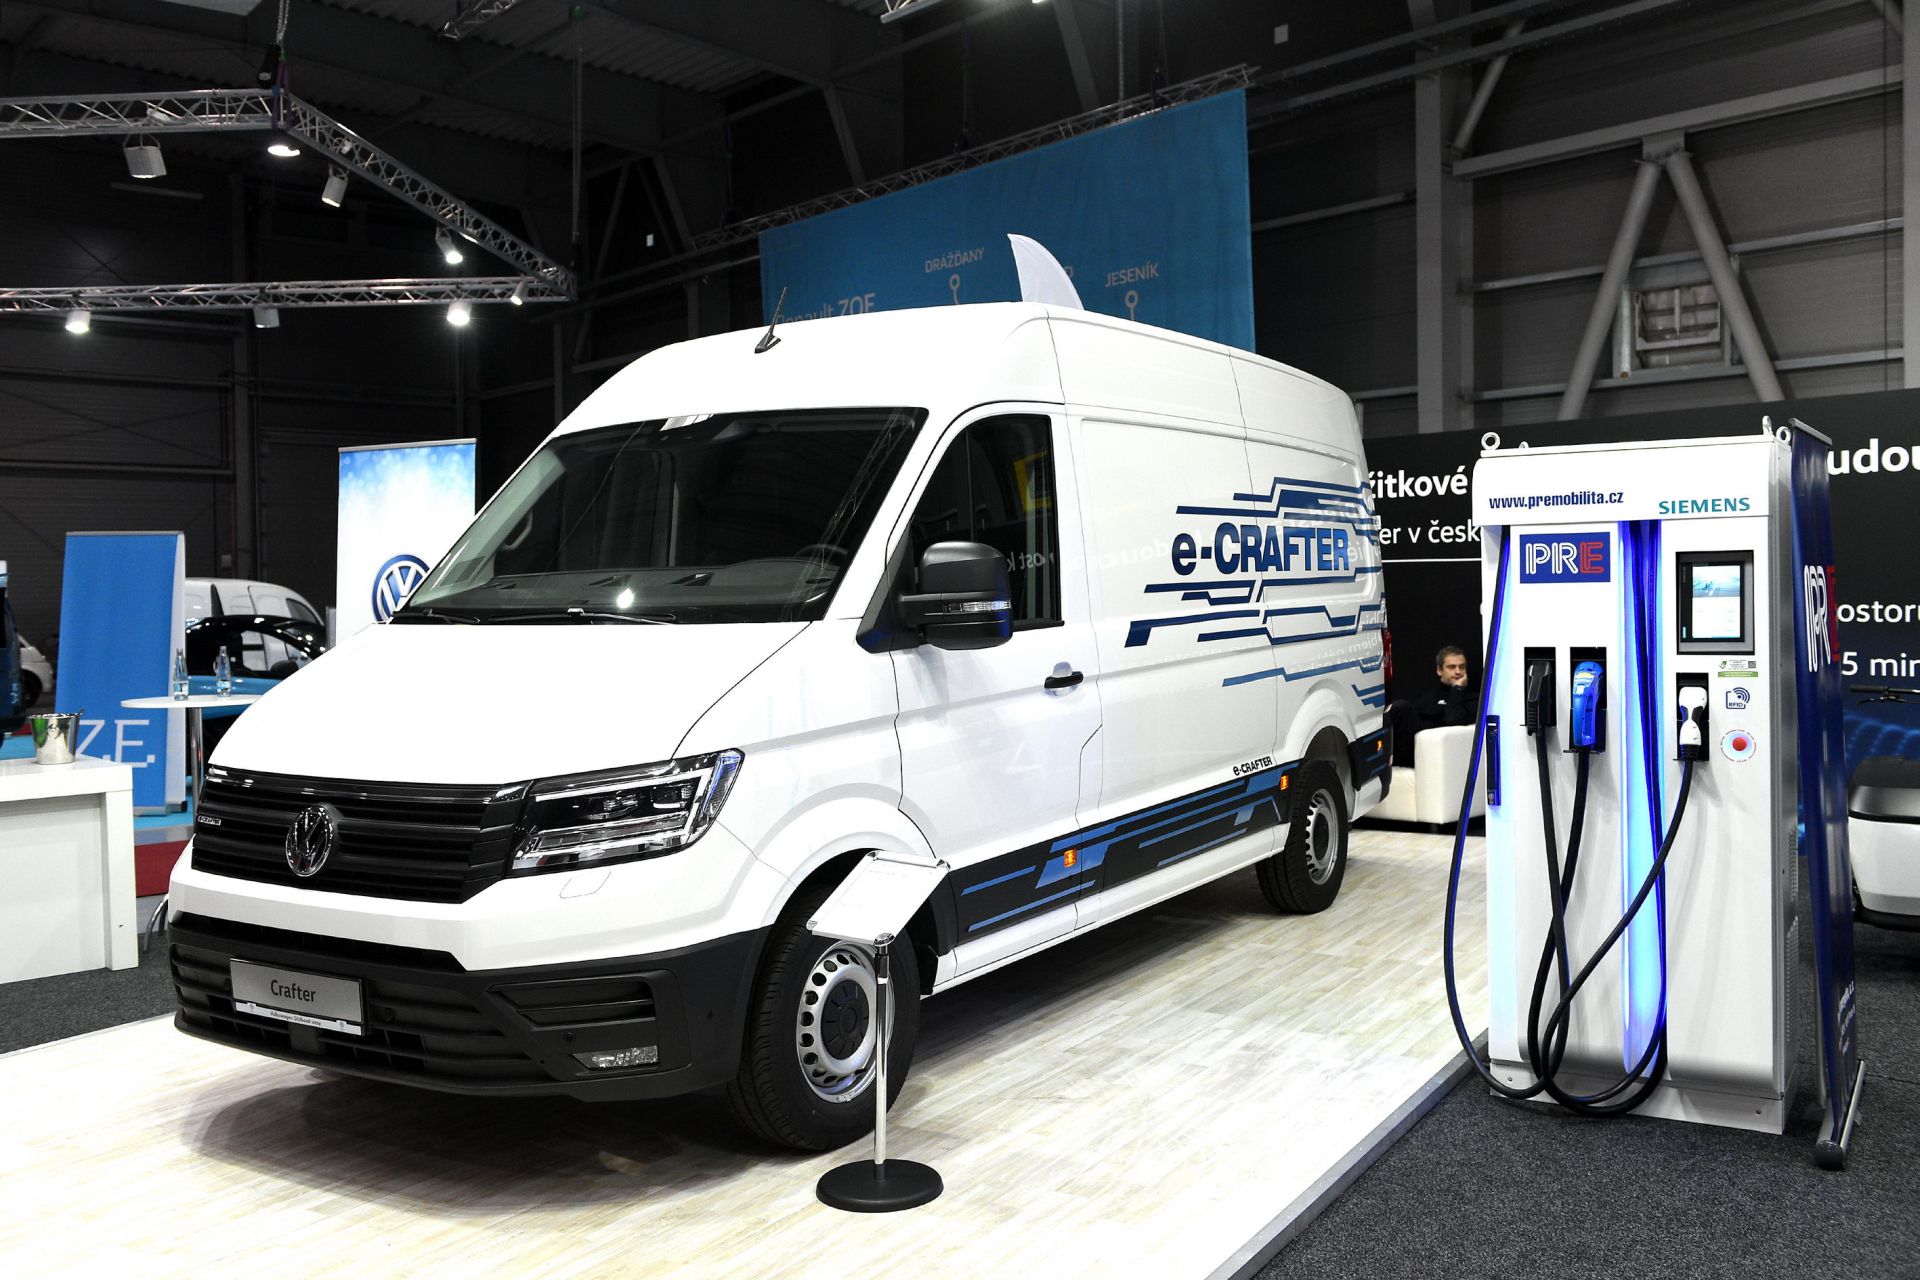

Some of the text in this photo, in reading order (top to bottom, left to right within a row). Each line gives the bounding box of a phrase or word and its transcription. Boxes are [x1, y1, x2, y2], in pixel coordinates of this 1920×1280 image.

[1104, 260, 1160, 288] JESENÍK
[1488, 491, 1625, 510] www.premobilita.cz
[1658, 497, 1751, 515] SIEMENS
[1408, 527, 1421, 543] v
[1171, 521, 1350, 576] e-CRAFTER
[1525, 541, 1605, 575] PRE
[1837, 601, 1920, 623] ostor
[1841, 651, 1859, 676] 5
[1232, 756, 1273, 776] e-CRAFTER
[270, 979, 316, 1002] Crafter
